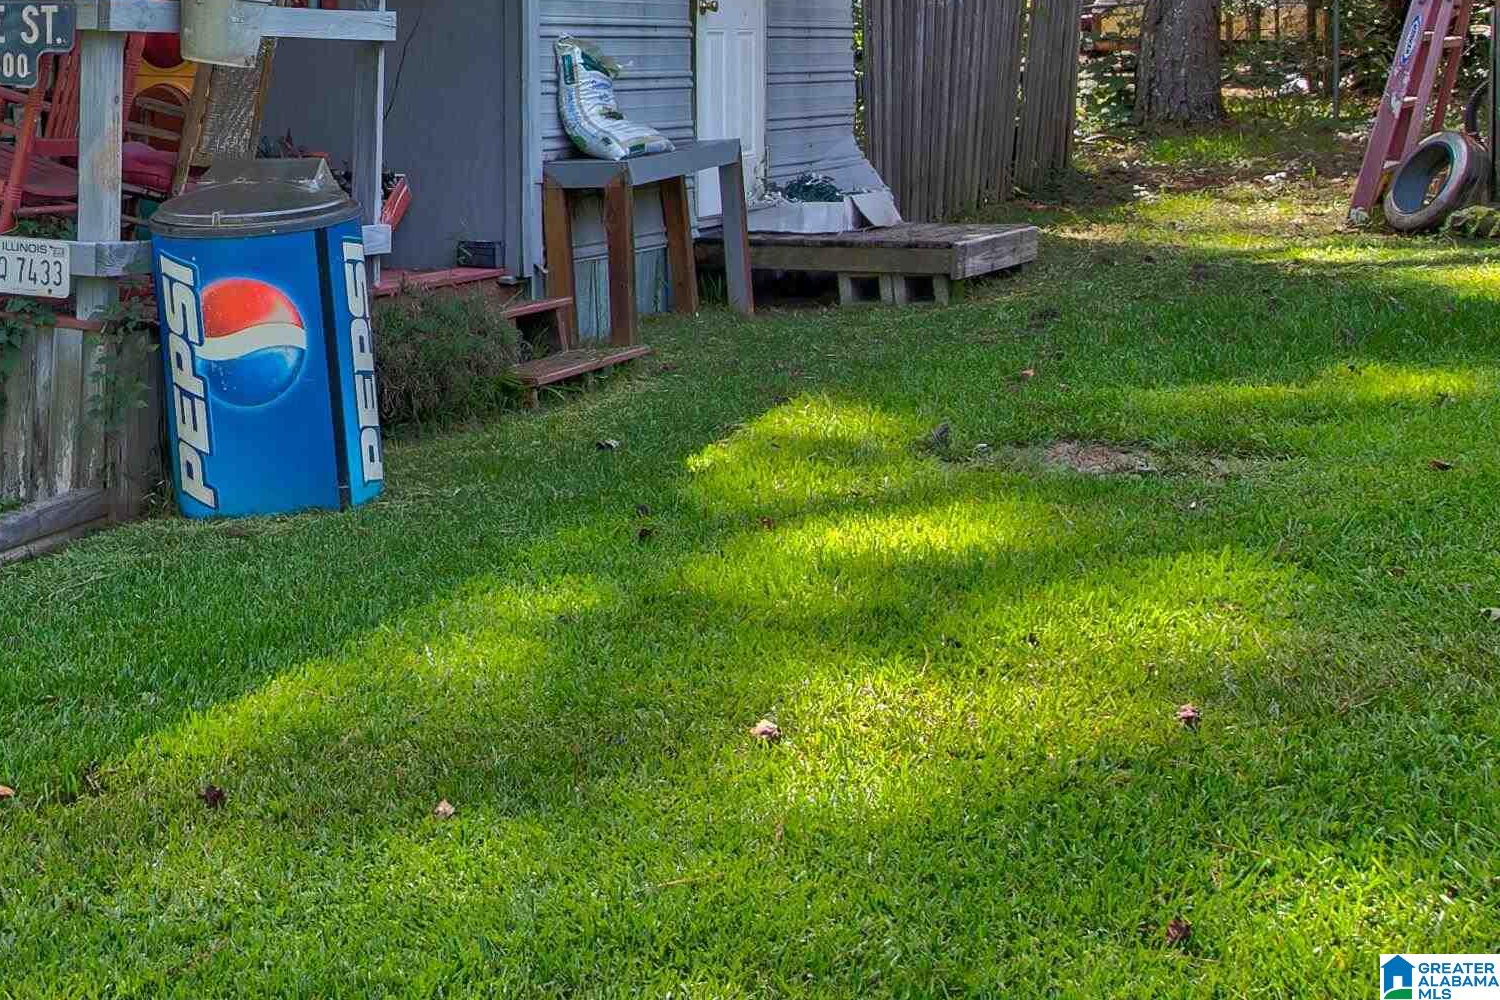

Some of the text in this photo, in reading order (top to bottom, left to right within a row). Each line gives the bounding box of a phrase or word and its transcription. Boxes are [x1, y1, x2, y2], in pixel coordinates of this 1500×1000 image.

[20, 4, 63, 45] ST.
[2, 240, 48, 254] ILLINOIS
[17, 257, 62, 287] 7433
[159, 251, 219, 509] PEPSI
[343, 237, 384, 483] PEPSI
